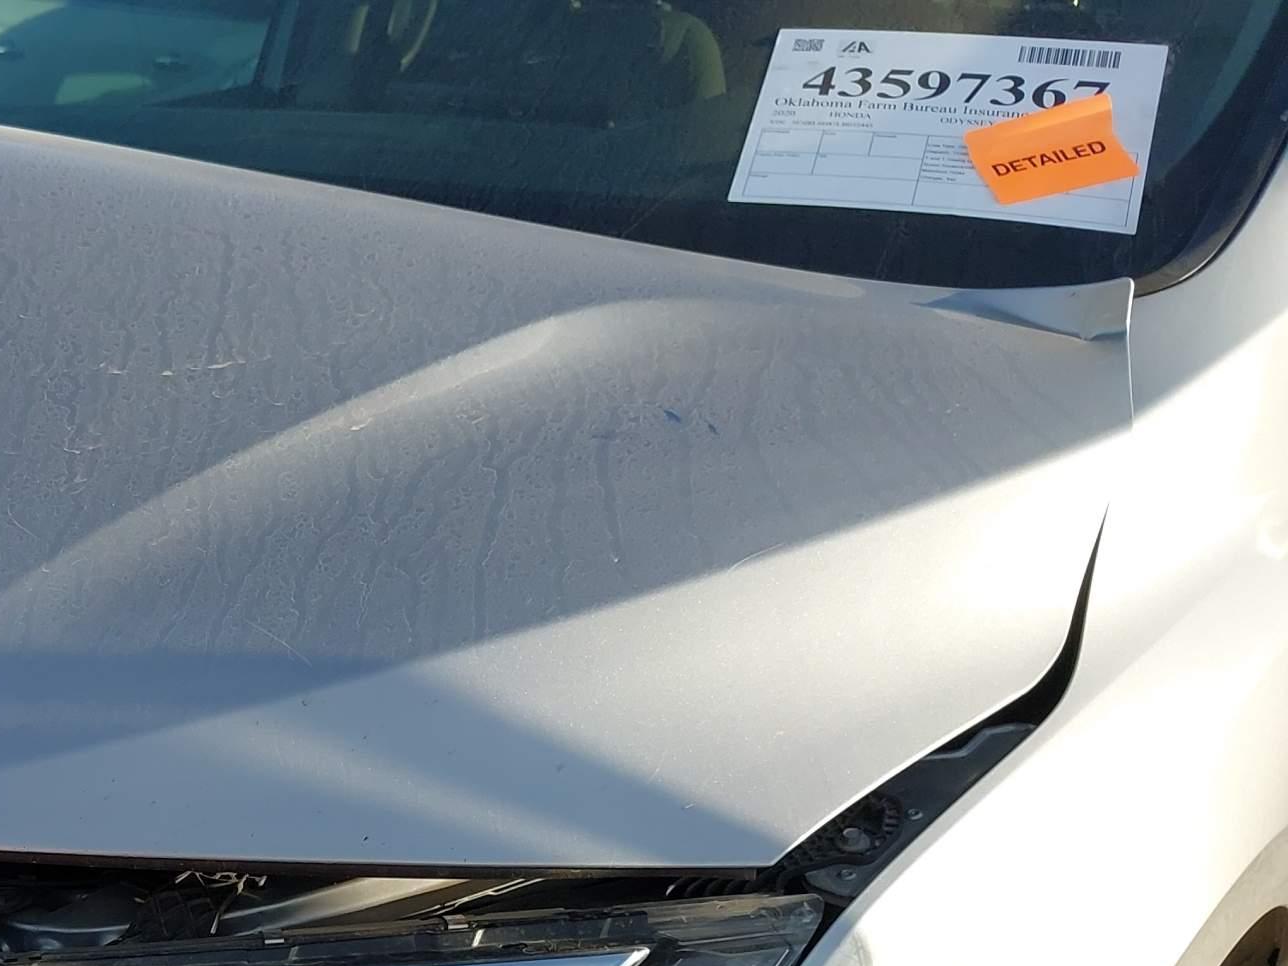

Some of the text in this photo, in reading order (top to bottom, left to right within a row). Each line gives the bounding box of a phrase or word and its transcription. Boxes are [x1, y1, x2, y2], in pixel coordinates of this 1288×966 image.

[801, 65, 1111, 110] 43597367
[775, 97, 853, 108] Oklahoma
[858, 99, 897, 110] Farm
[903, 102, 958, 115] Bureau
[829, 110, 872, 119] HONDA
[940, 117, 994, 127] ODYSSEY
[991, 140, 1107, 177] DETAILED
